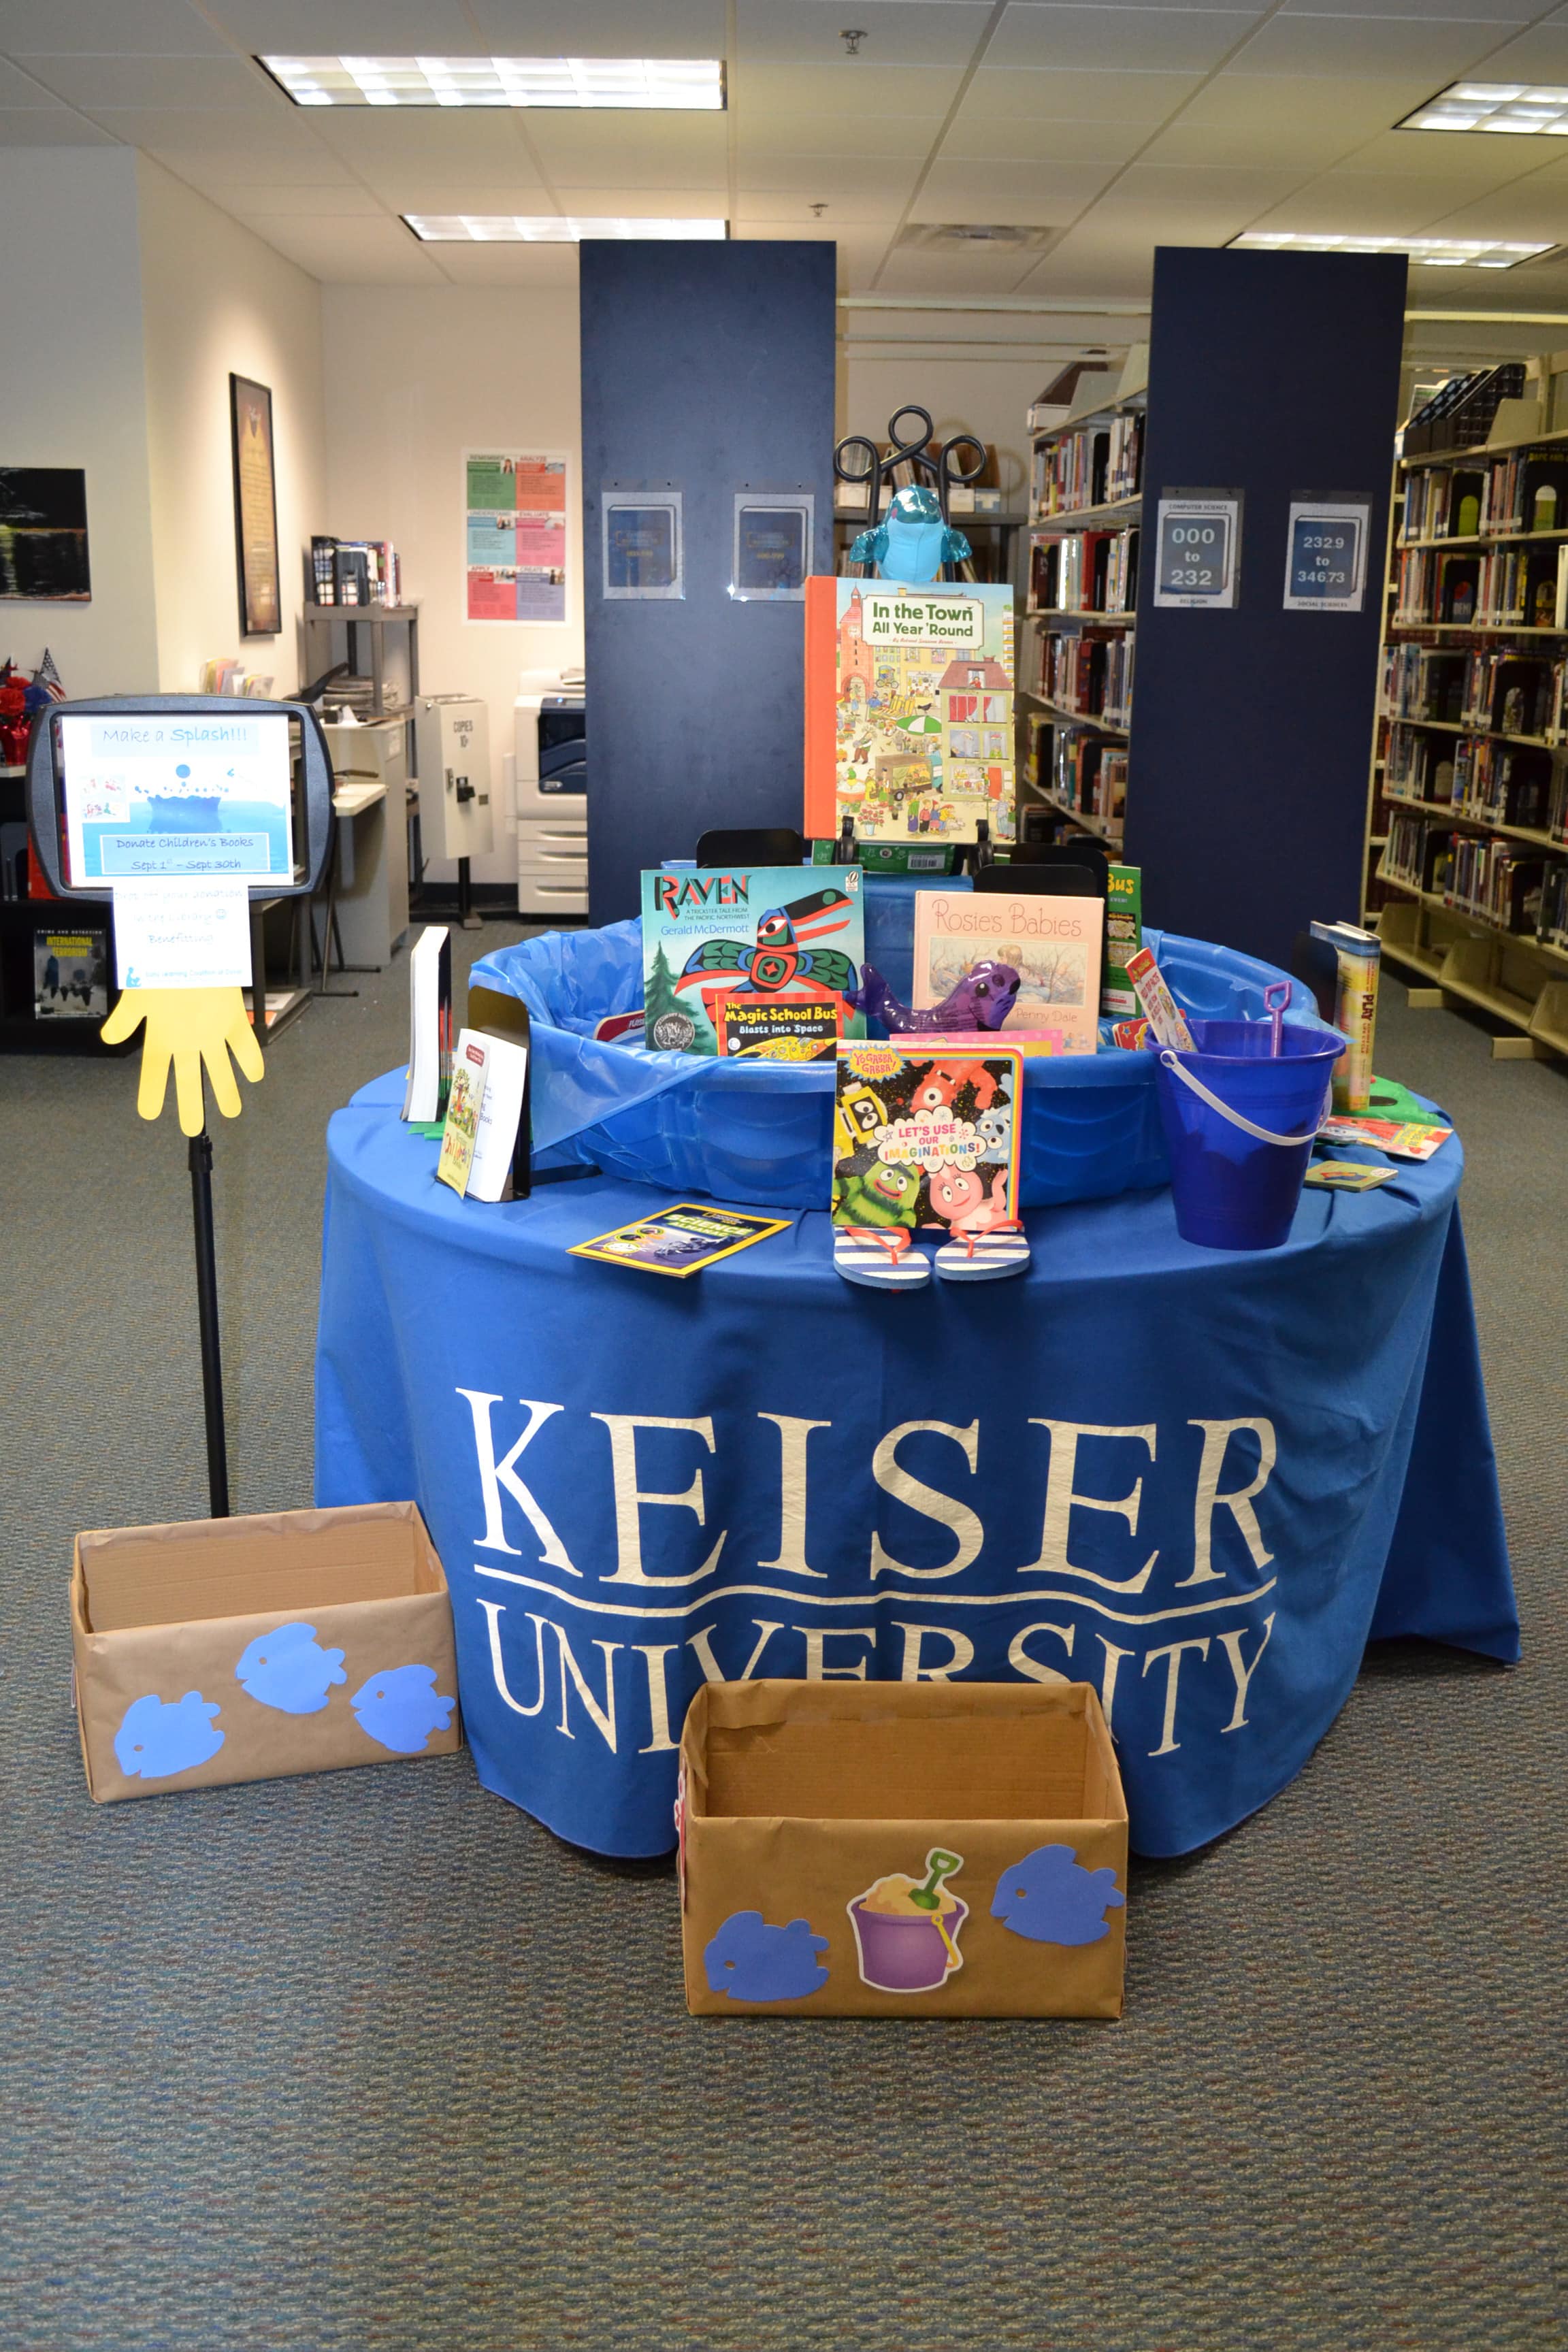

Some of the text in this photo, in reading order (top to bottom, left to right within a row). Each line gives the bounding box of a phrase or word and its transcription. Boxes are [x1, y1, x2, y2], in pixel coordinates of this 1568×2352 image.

[1171, 527, 1215, 544] 000
[1303, 536, 1345, 549] 232.9
[1184, 551, 1200, 563] to
[1316, 555, 1330, 566] to
[1171, 570, 1213, 585] 232
[1297, 570, 1345, 583] 346.73
[873, 602, 973, 621] In the Town
[872, 621, 973, 637] All Year 'Round
[453, 719, 474, 734] COPIES
[103, 727, 247, 747] Make a Splash!!!
[116, 836, 254, 849] Donate Children's Books
[131, 861, 158, 871] Sept
[186, 860, 213, 870] Sept
[214, 859, 241, 868] 30th
[654, 875, 751, 920] RAVEN
[932, 898, 1082, 937] Rosie's Babies
[661, 924, 749, 936] Gerald McDermott
[46, 936, 93, 947] INTERNATIONAL
[726, 1002, 742, 1011] The
[1361, 994, 1374, 1021] PLAY
[724, 1006, 838, 1024] Magic School Bus
[1015, 1008, 1078, 1024] Penny Dale
[739, 1024, 823, 1034] Blasts into Space
[865, 1054, 894, 1064] GABBA
[862, 1060, 897, 1075] GABBA!
[898, 1124, 957, 1138] LET'S USE
[919, 1136, 938, 1145] OUR
[885, 1142, 980, 1161] IMAGINATIONS!
[665, 1213, 751, 1236] SCIENCE
[668, 1222, 730, 1237] ALMANAC
[455, 1387, 1278, 1594] KEISER
